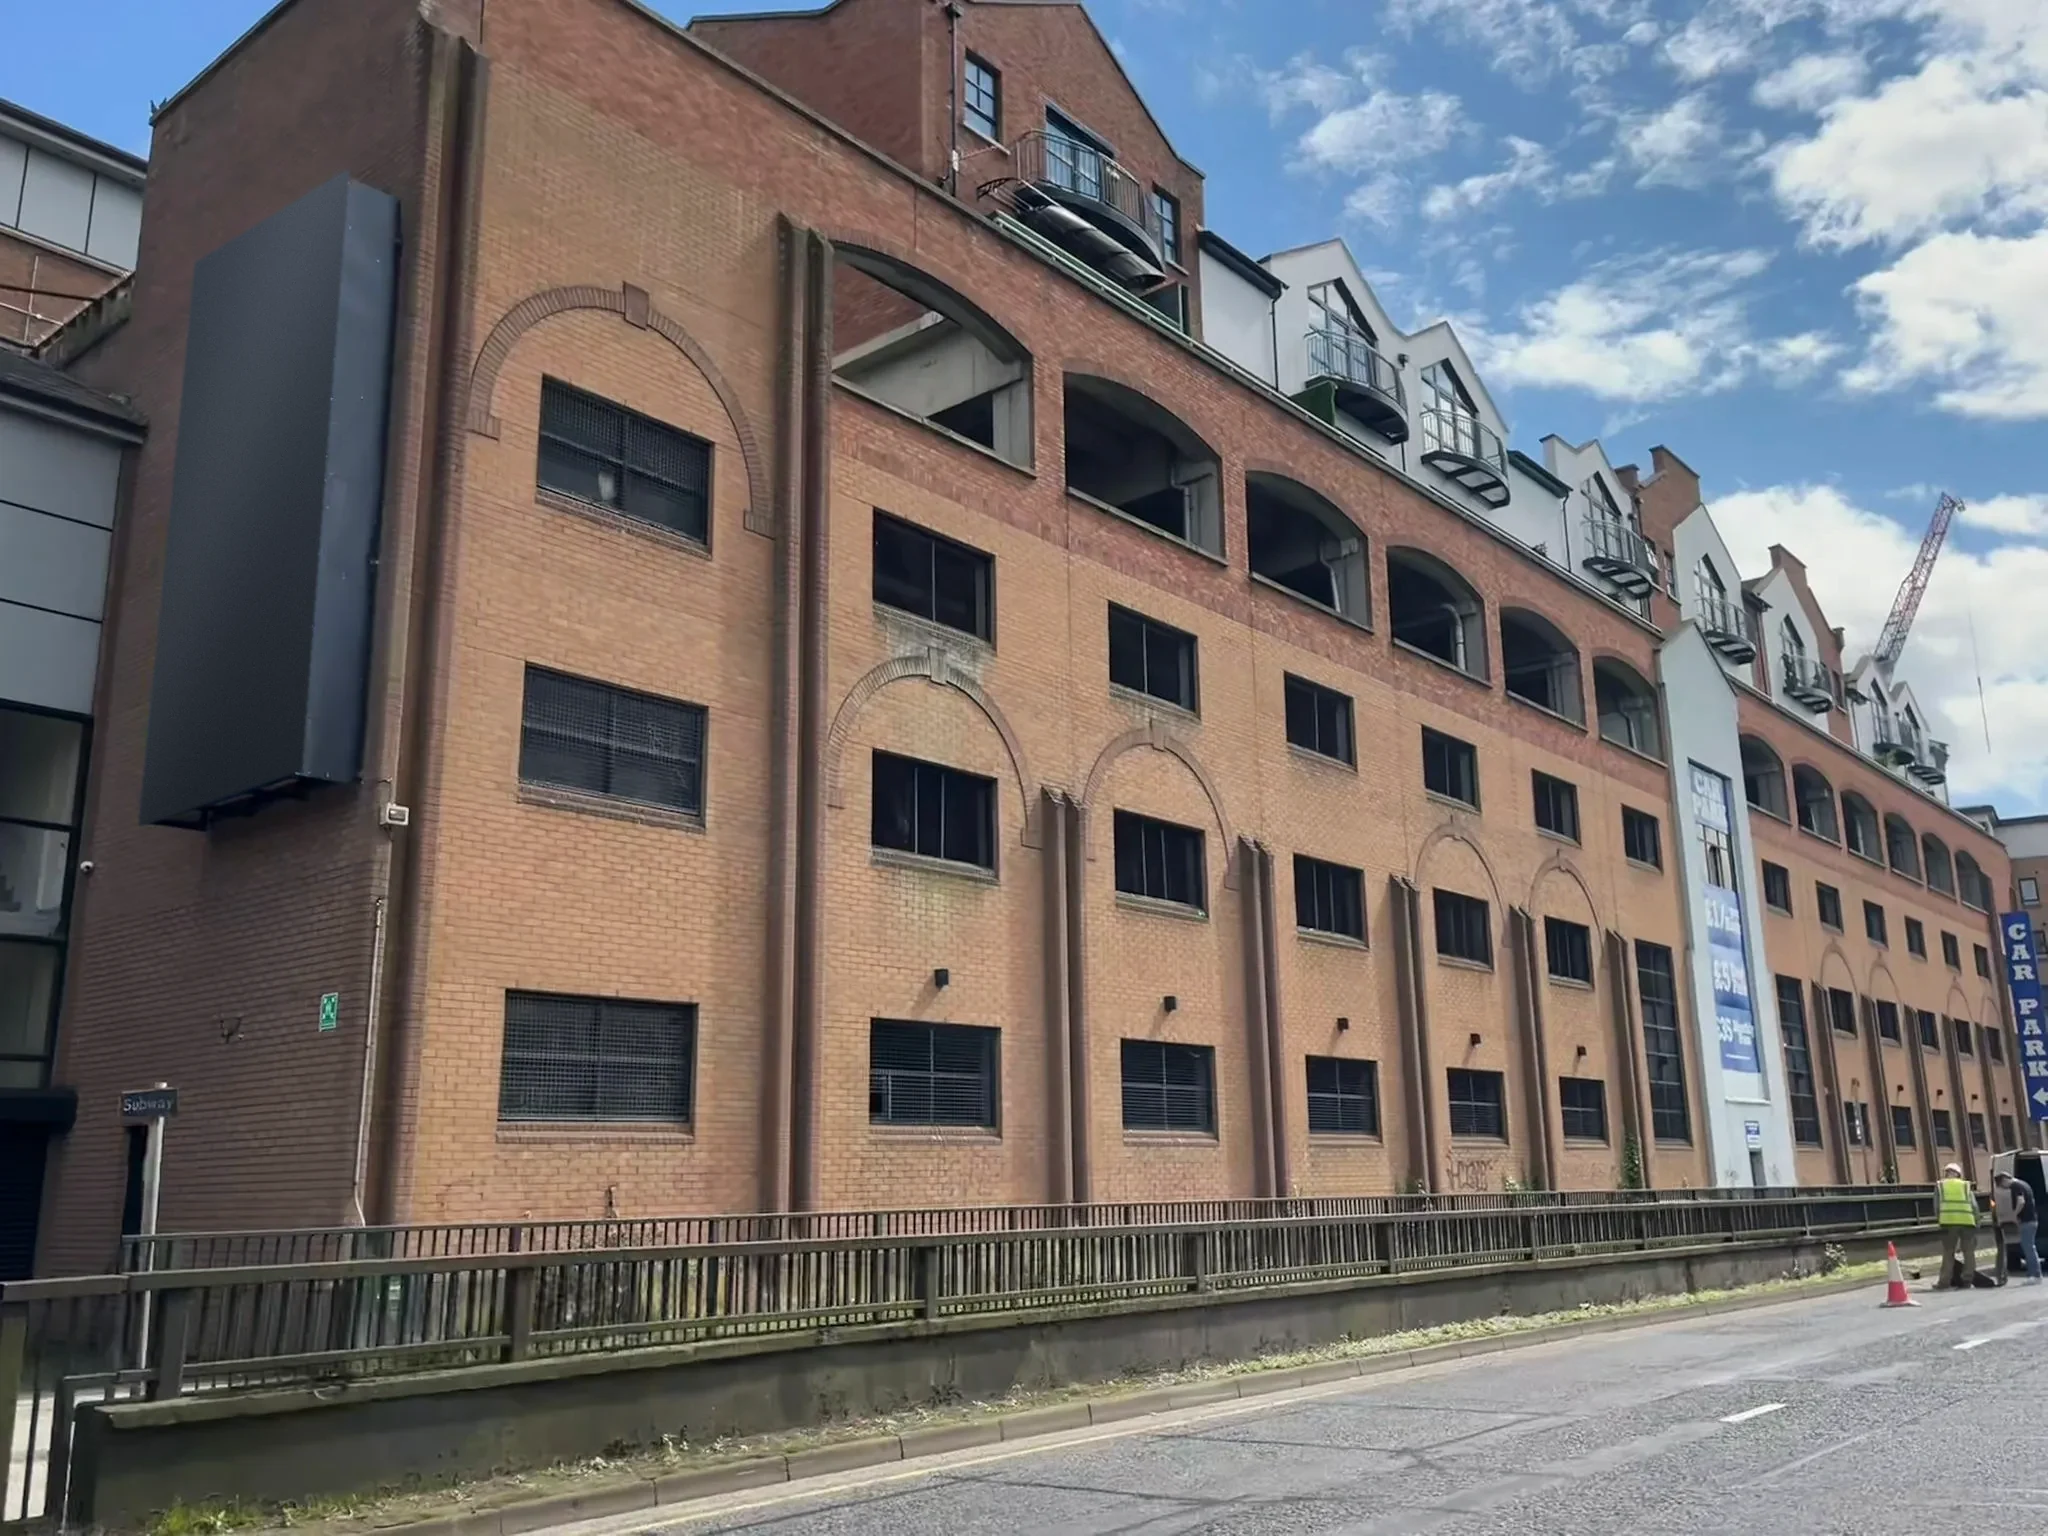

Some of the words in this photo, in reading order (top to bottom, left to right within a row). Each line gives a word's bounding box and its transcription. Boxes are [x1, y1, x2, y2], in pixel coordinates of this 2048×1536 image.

[1694, 770, 1721, 800] CAR
[1692, 793, 1728, 826] PARK
[2008, 923, 2035, 981] CAR
[2018, 998, 2048, 1077] PARK
[123, 1097, 174, 1112] Subway
